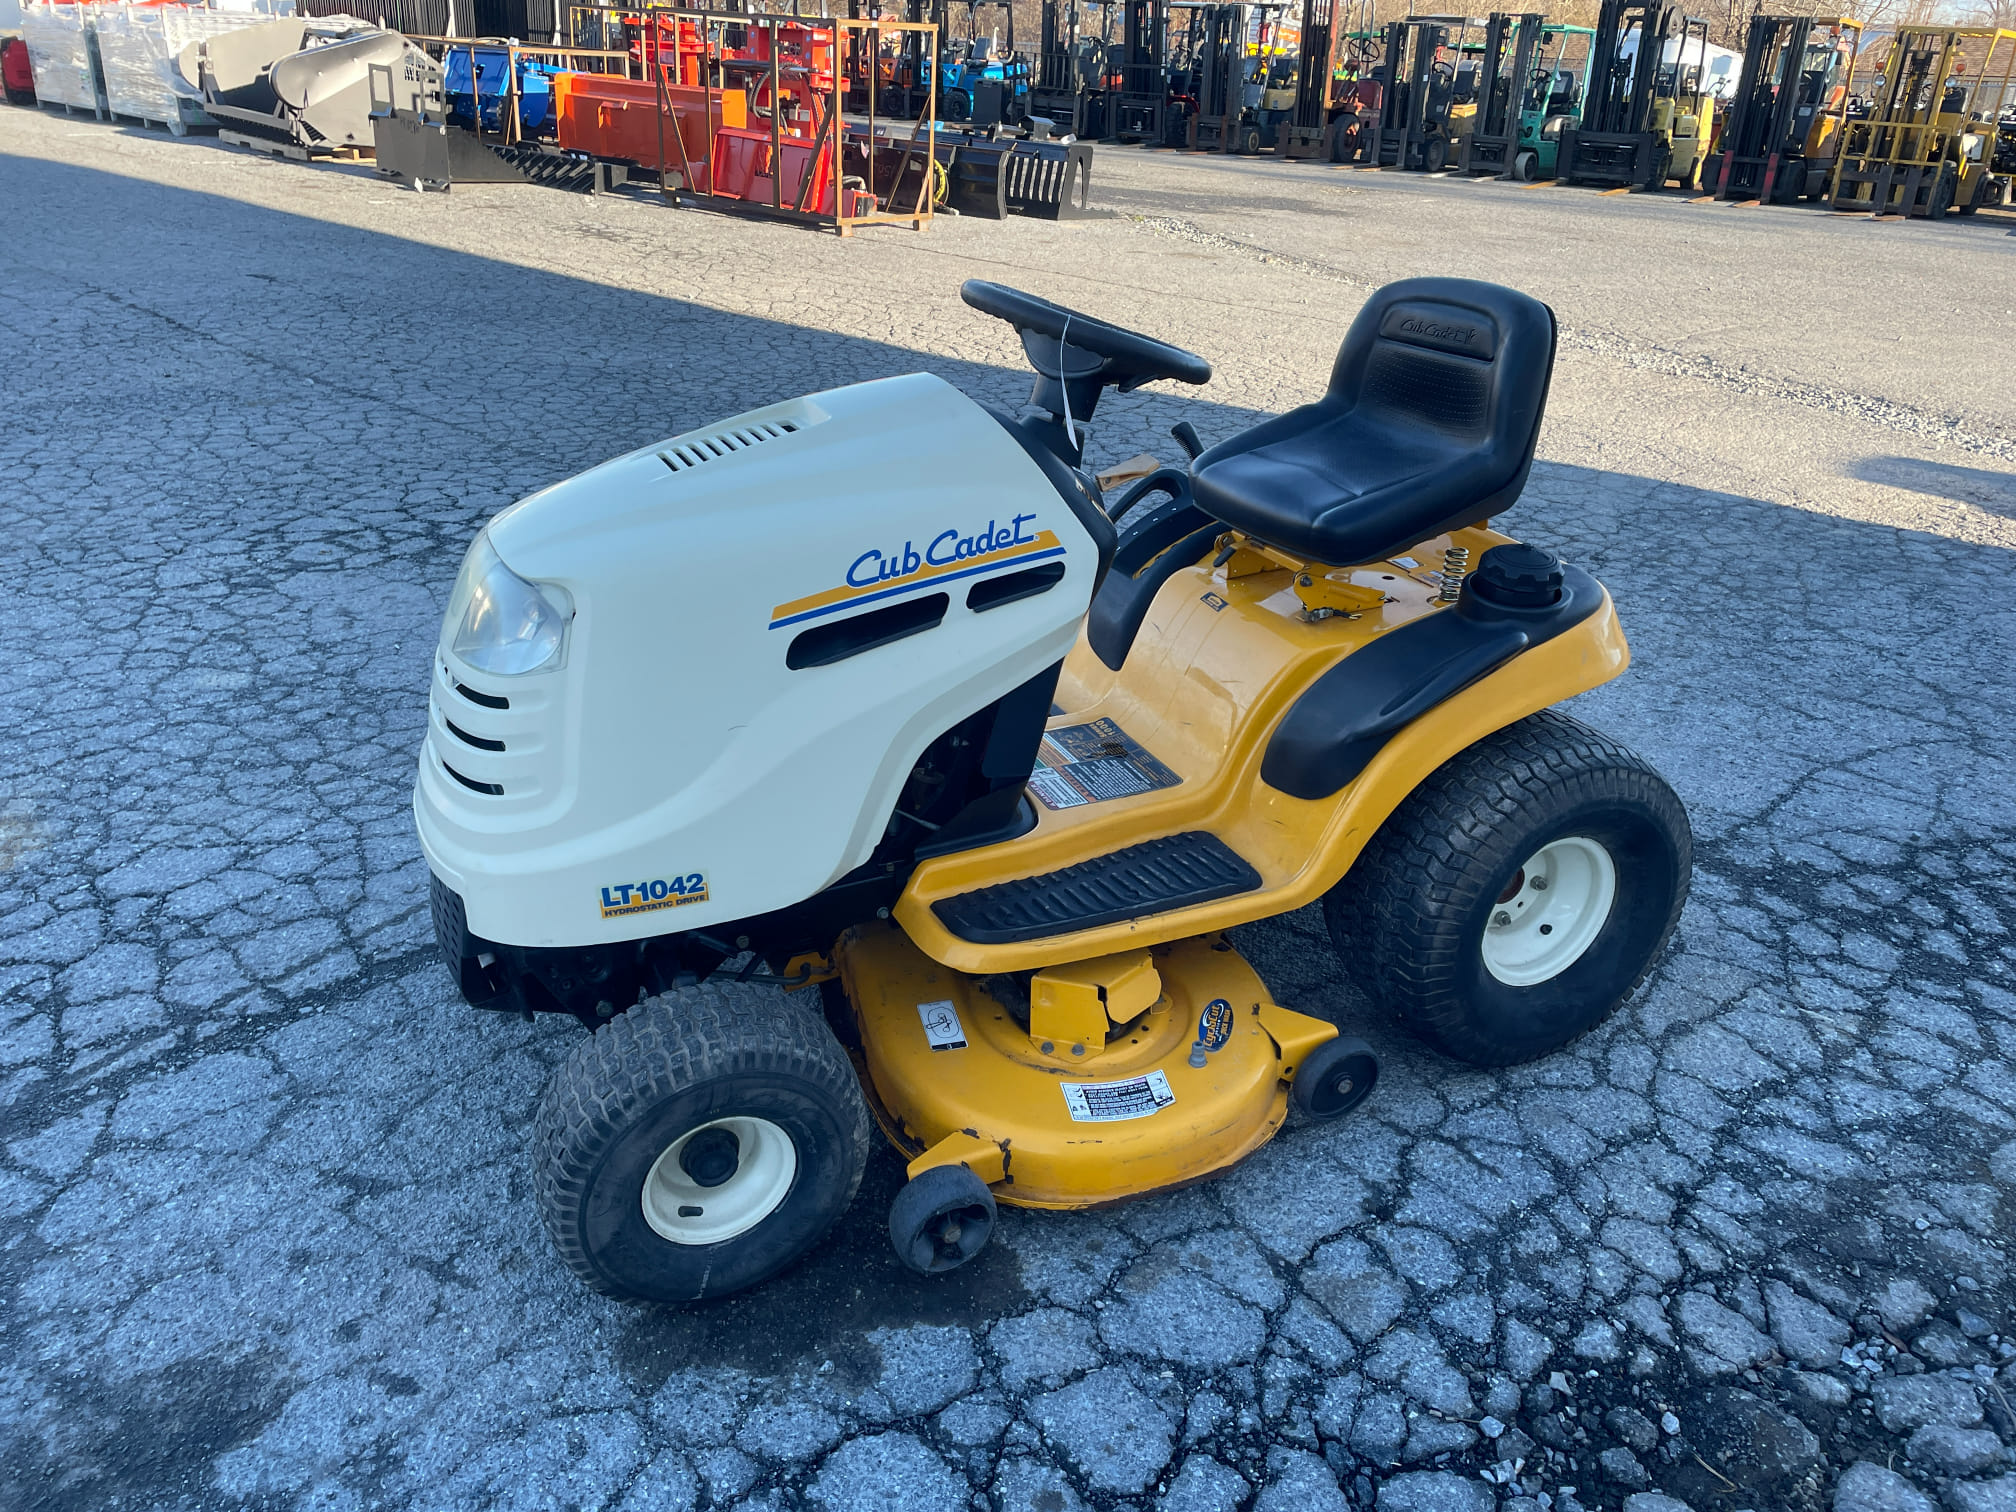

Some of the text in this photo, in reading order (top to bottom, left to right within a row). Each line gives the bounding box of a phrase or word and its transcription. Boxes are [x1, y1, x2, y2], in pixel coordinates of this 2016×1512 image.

[847, 513, 1036, 587] Cub Cadet
[601, 873, 705, 907] LT1042
[604, 895, 705, 917] HYDROSTATIC DRIVE
